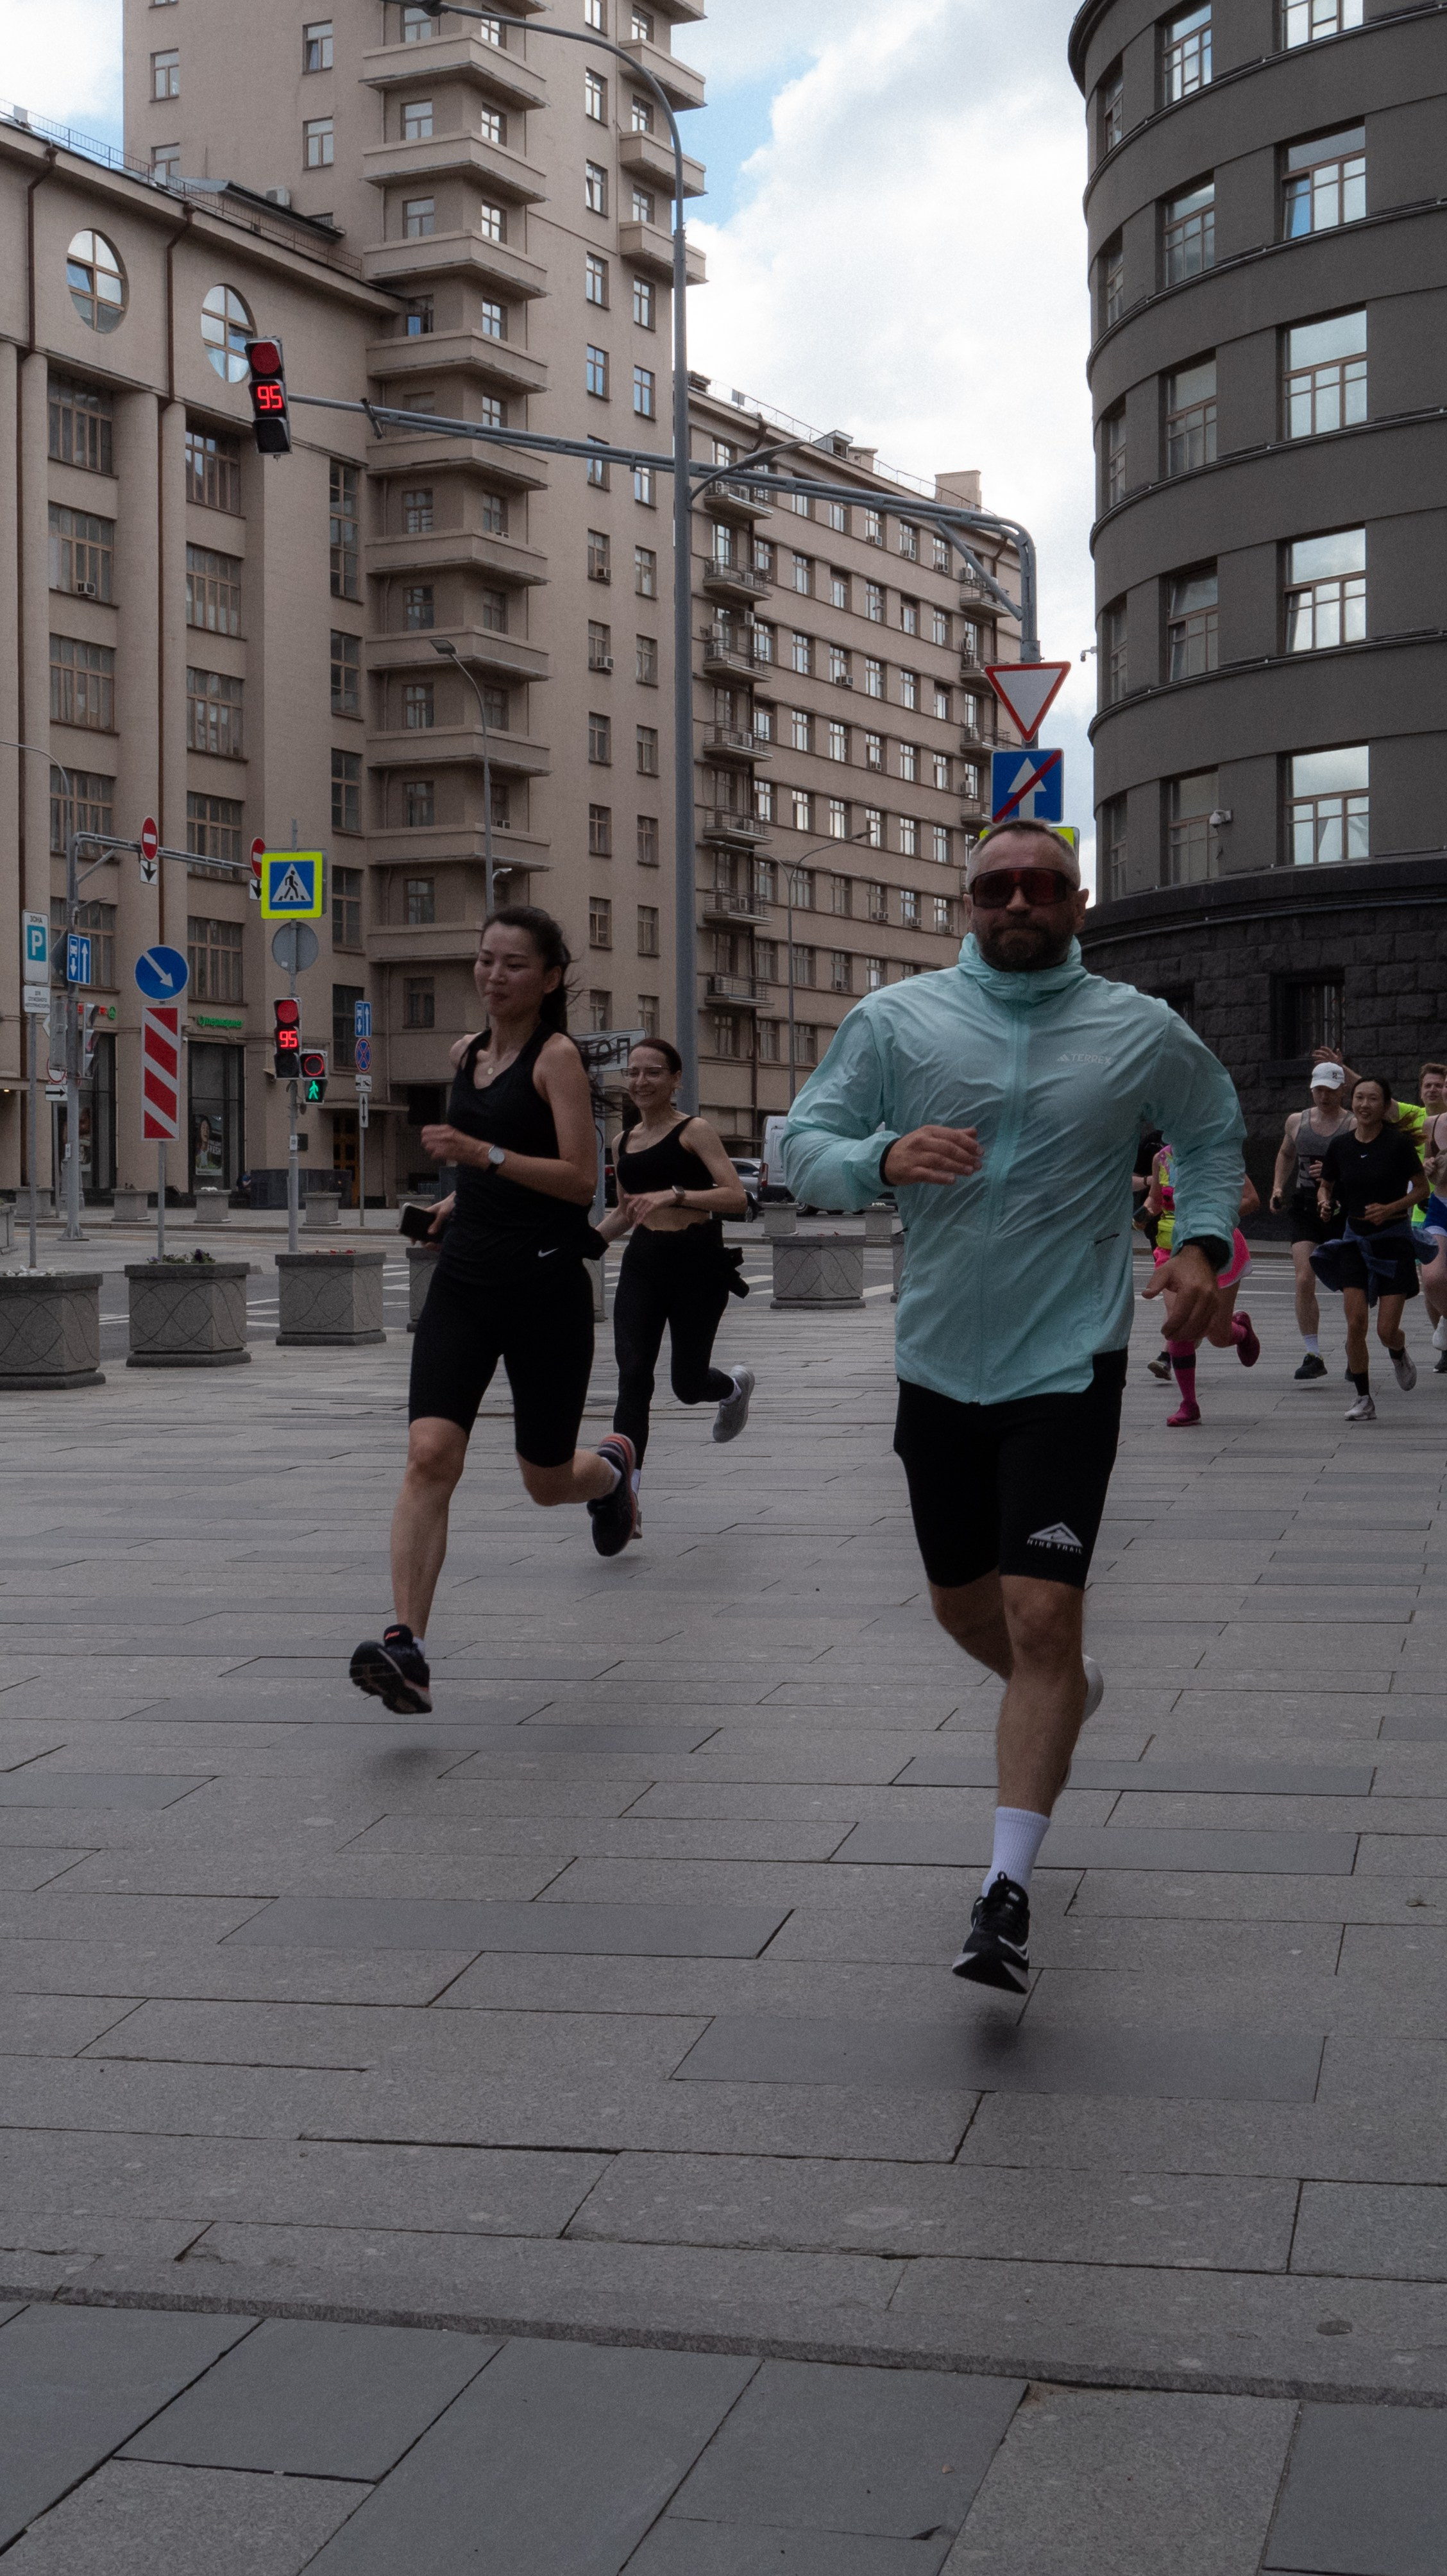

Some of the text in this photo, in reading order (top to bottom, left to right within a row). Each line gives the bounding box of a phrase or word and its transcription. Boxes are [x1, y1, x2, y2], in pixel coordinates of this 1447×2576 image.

[257, 386, 282, 409] 95
[30, 915, 43, 924] ЗОНА
[31, 930, 43, 956] P
[279, 1031, 298, 1047] 95
[1072, 1053, 1112, 1065] TERREX
[1027, 1539, 1082, 1554] NIKE TRAIL
